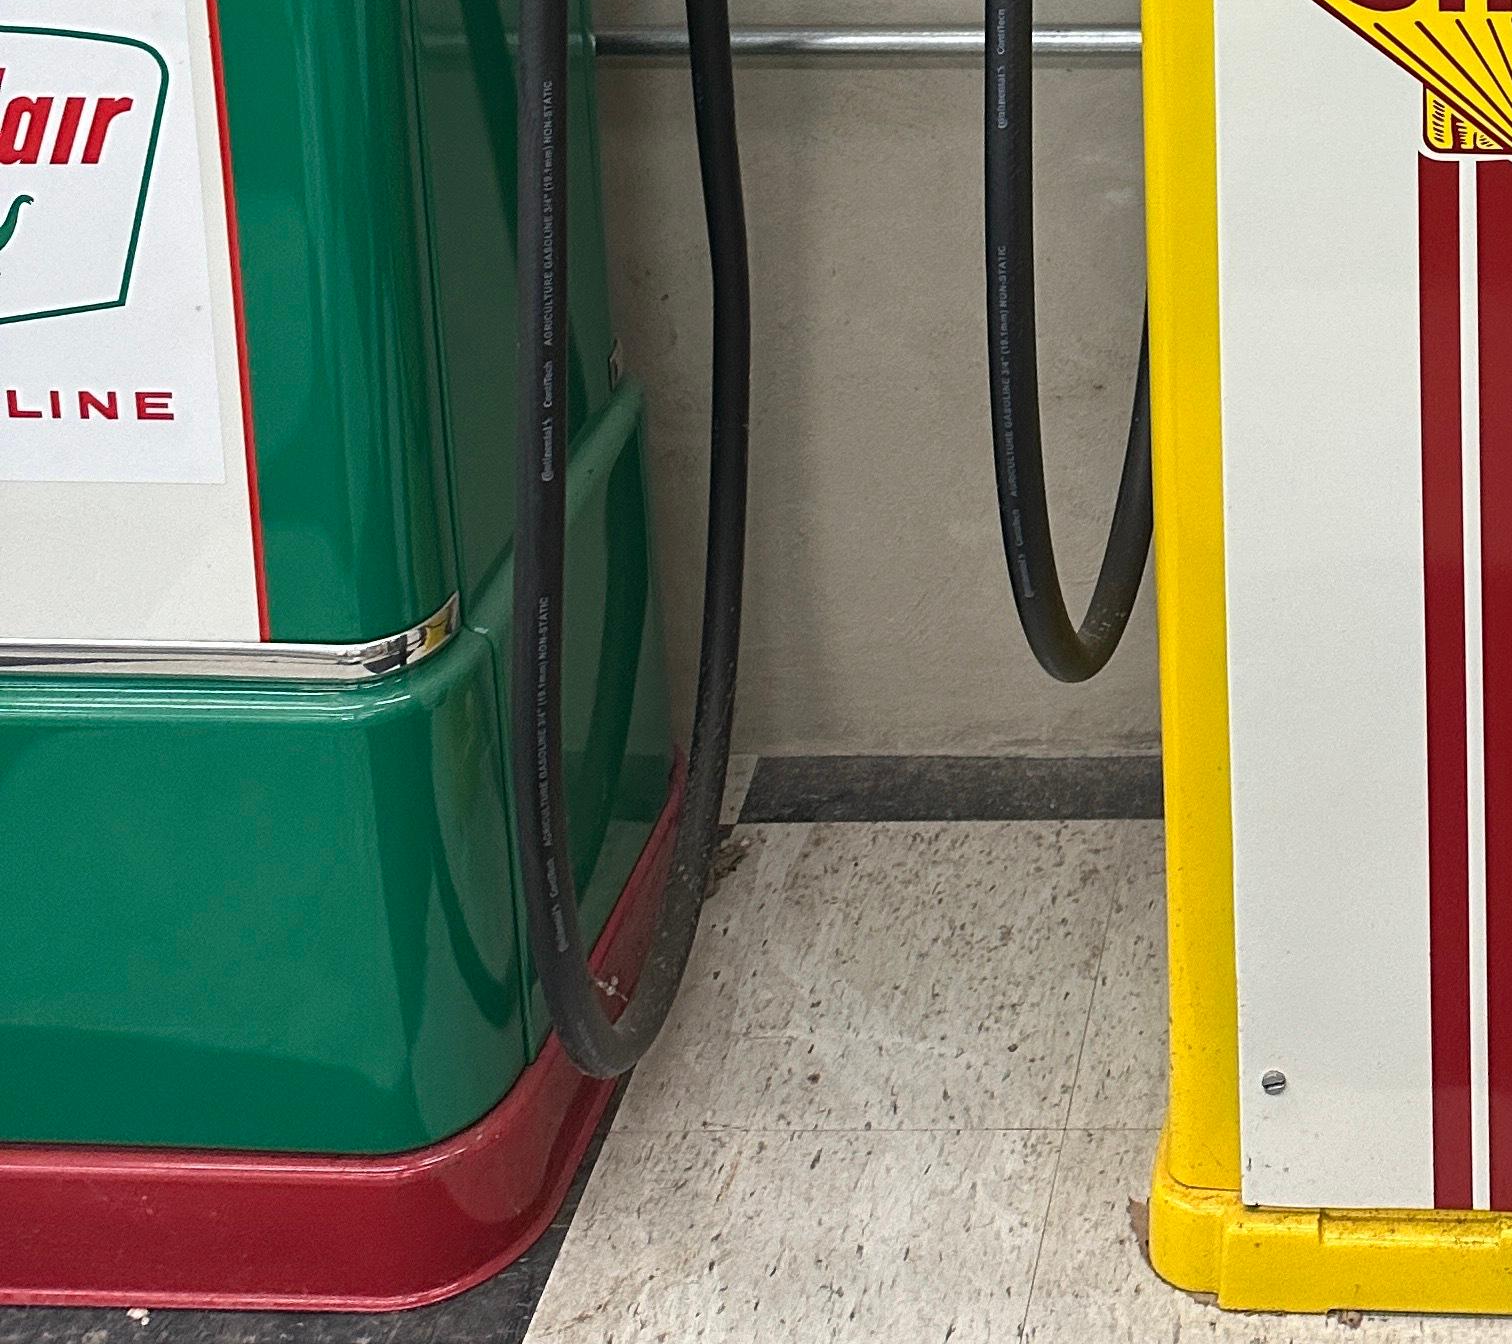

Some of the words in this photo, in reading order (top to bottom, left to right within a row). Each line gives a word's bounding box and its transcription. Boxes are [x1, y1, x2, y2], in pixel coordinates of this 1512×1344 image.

[0, 68, 133, 165] air
[543, 80, 553, 144] NON-STATIC
[543, 215, 554, 269] GASOLINE
[998, 244, 1009, 308] NON-STATIC
[543, 272, 554, 346] AGRICULTURE
[6, 389, 175, 421] LINE
[538, 596, 550, 659] NON-STATIC
